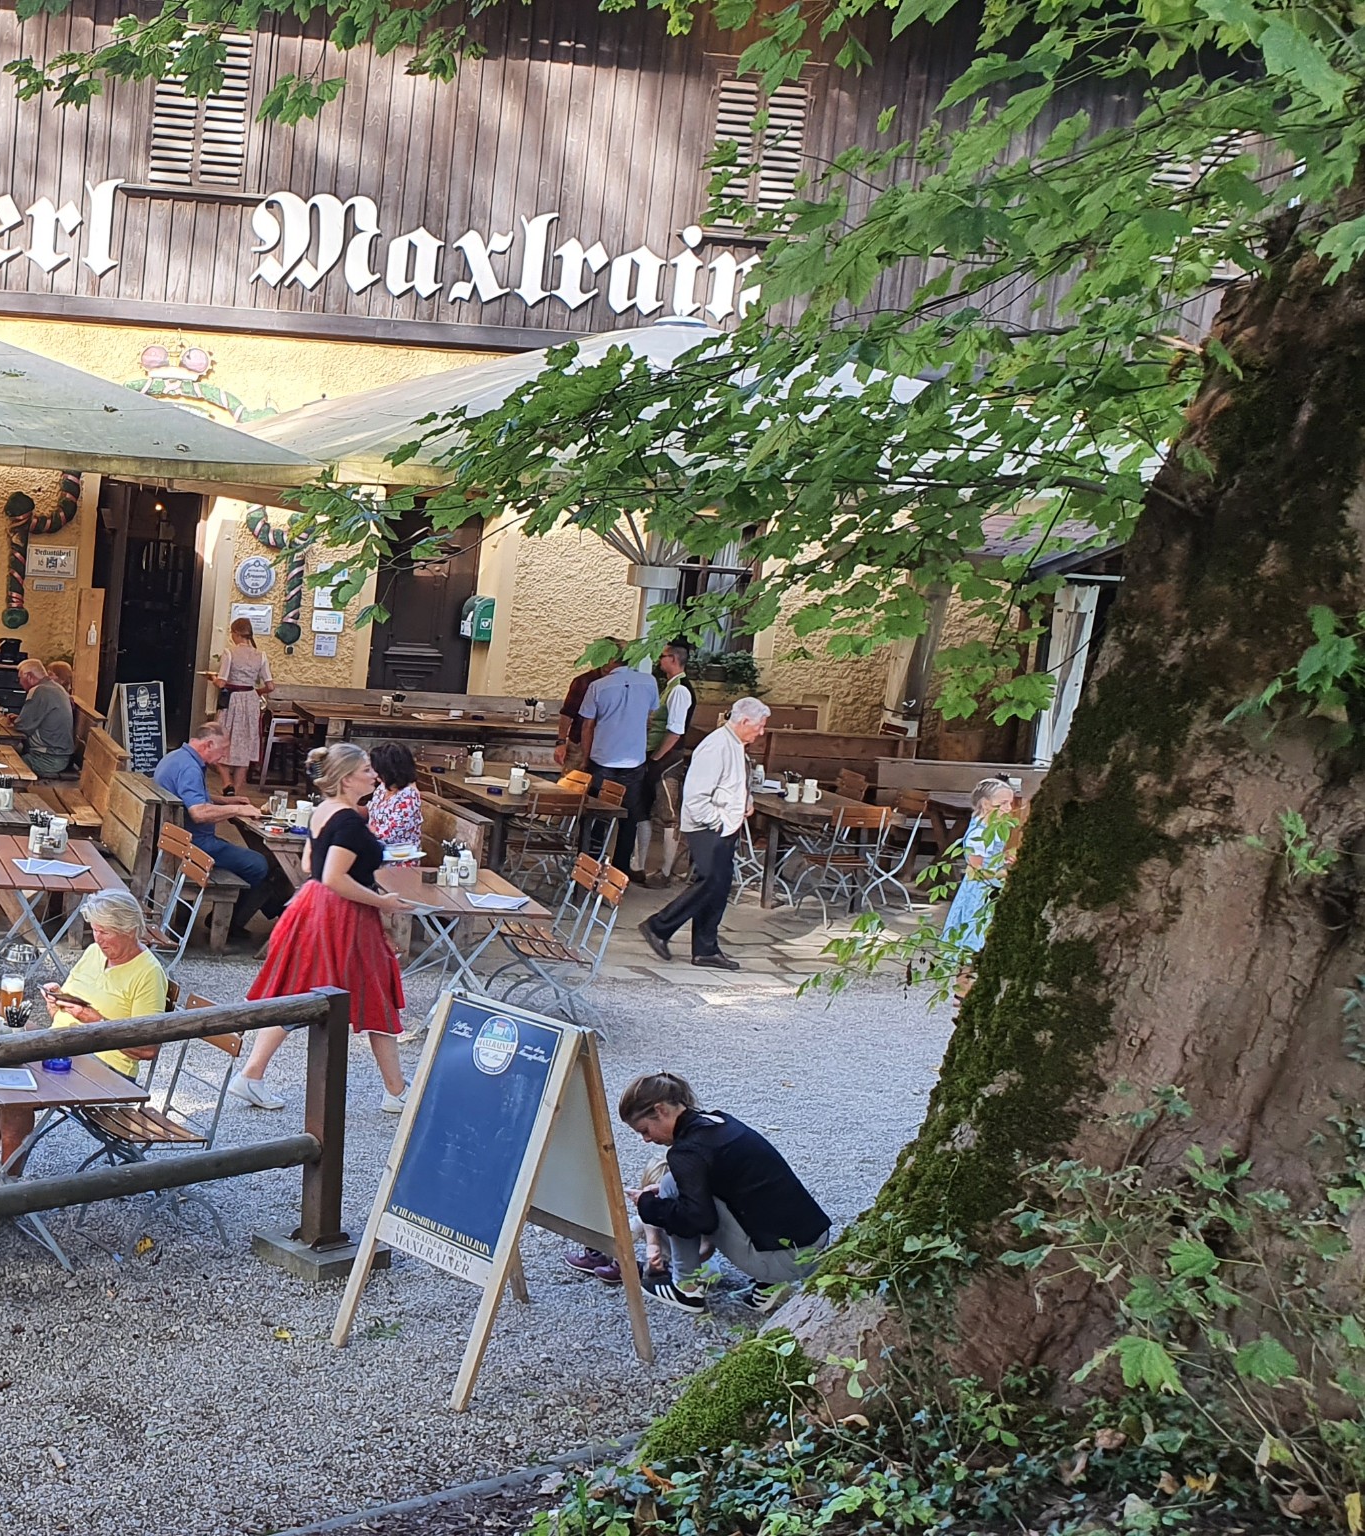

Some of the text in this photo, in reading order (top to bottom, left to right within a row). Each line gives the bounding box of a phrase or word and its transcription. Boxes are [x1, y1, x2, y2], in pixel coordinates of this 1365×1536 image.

[390, 1203, 492, 1255] SCHLOSSBRAUEREI MAXLRAIN
[393, 1232, 470, 1276] MAXLRAINER
[442, 1245, 473, 1263] TRINKT
